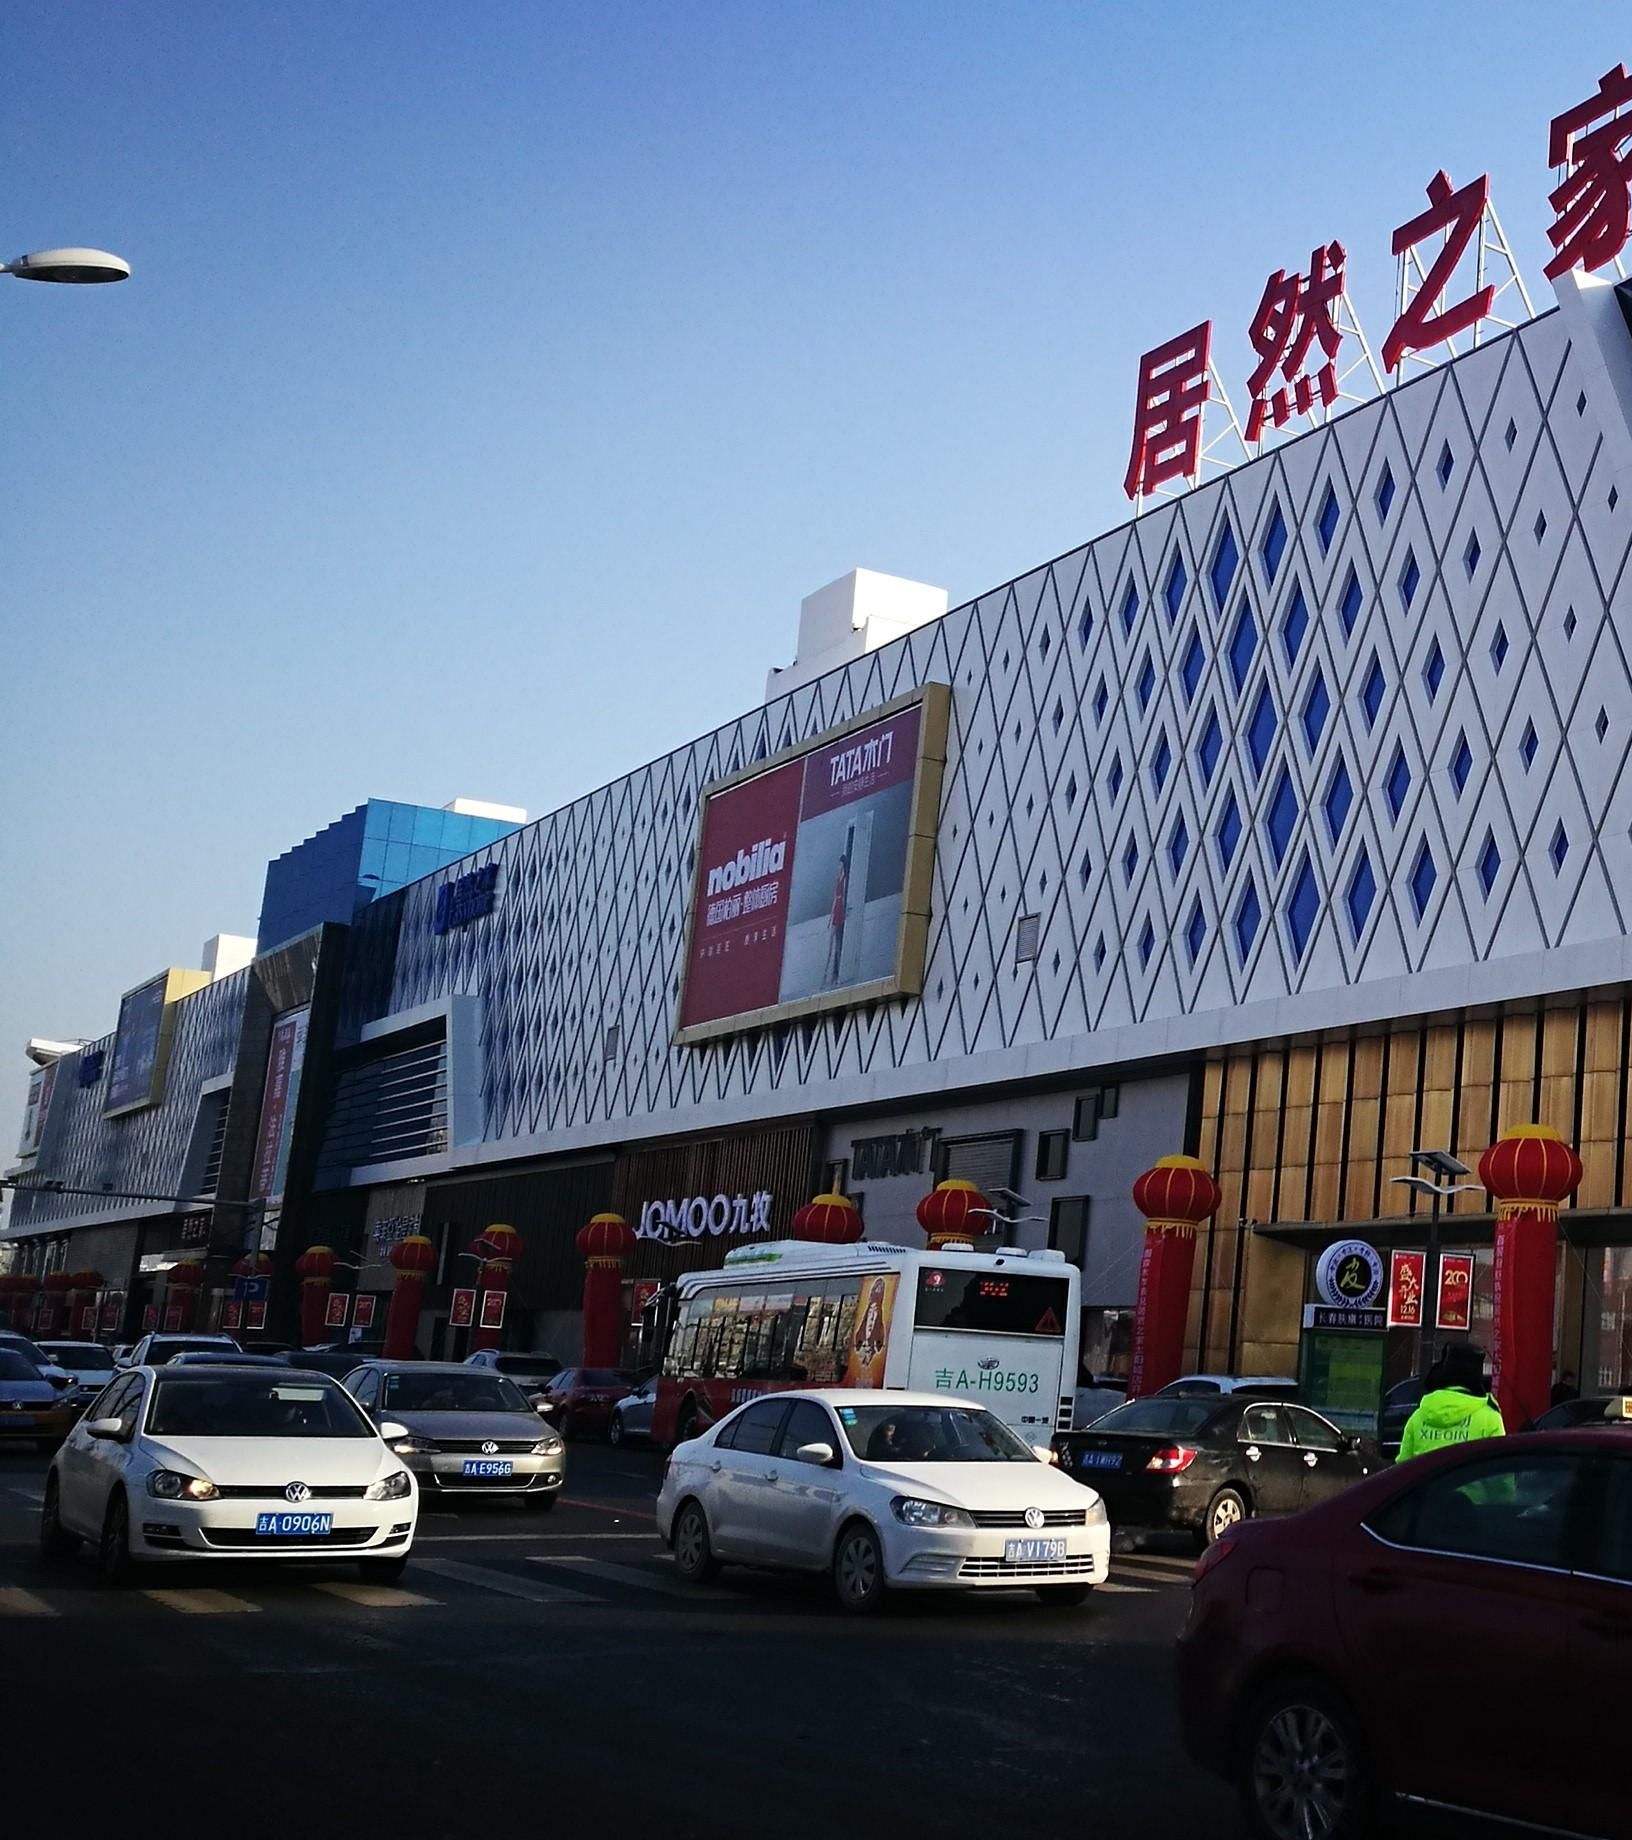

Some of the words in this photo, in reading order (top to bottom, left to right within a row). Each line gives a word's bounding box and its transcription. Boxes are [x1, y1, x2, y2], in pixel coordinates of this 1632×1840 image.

[830, 731, 894, 787] TATA木门
[706, 838, 787, 897] nobilia
[935, 1368, 1039, 1393] 吉A-H9593
